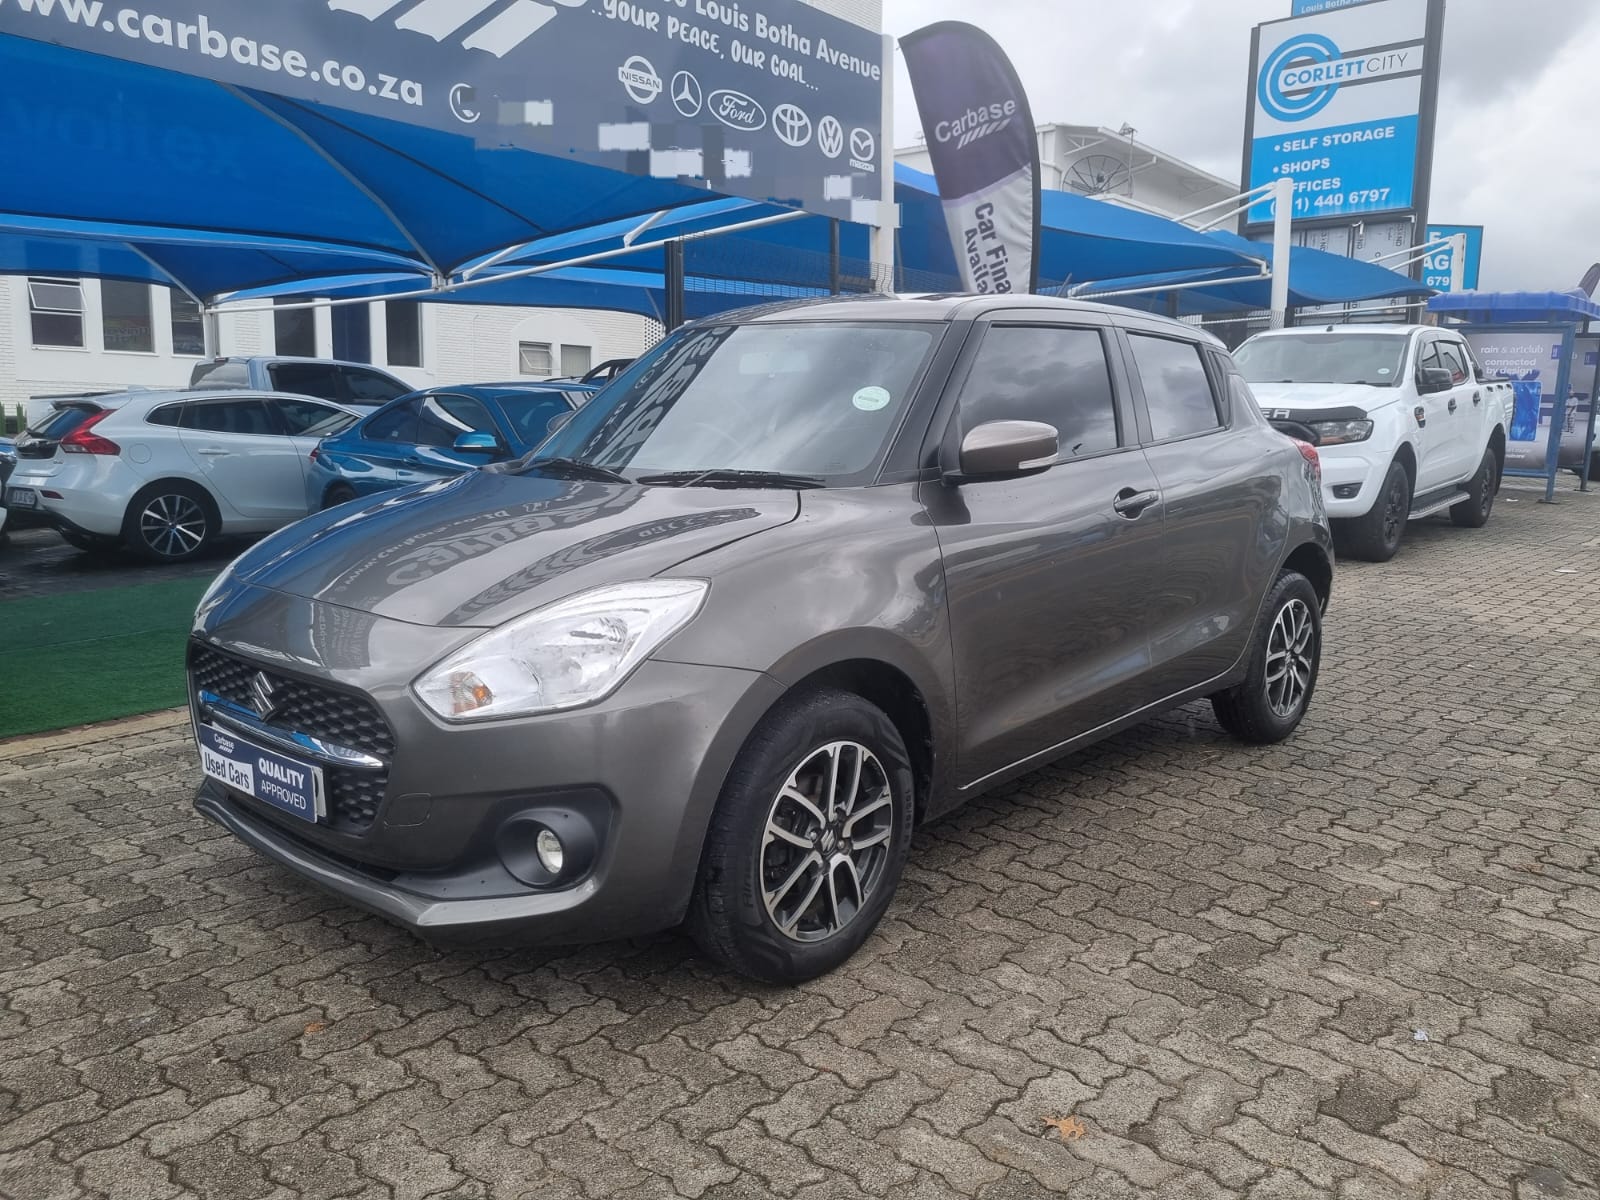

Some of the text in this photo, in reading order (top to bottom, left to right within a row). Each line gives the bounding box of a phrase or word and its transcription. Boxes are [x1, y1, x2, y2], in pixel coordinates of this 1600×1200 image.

[0, 0, 423, 106] ww.carbase.co.za
[667, 15, 725, 60] PEACE,
[730, 40, 766, 70] OUR
[695, 0, 881, 81] Louis Botha Avenue
[620, 70, 661, 89] NISSAN
[719, 94, 756, 124] Ford
[934, 99, 1016, 143] Carbase
[1282, 126, 1396, 153] SELF STORAGE
[1281, 157, 1330, 174] SHOPS
[1292, 177, 1342, 194] FFICES
[1313, 193, 1344, 208] 440
[1349, 187, 1391, 205] 6797
[964, 227, 994, 294] Availa
[975, 202, 1012, 294] Car Fina
[1480, 345, 1499, 354] rain
[1484, 358, 1537, 366] connected
[1486, 366, 1533, 377] by design
[213, 733, 235, 749] Carbase
[204, 751, 250, 789] Used Cars
[258, 757, 305, 790] QUALITY
[261, 780, 307, 811] APPROVED
